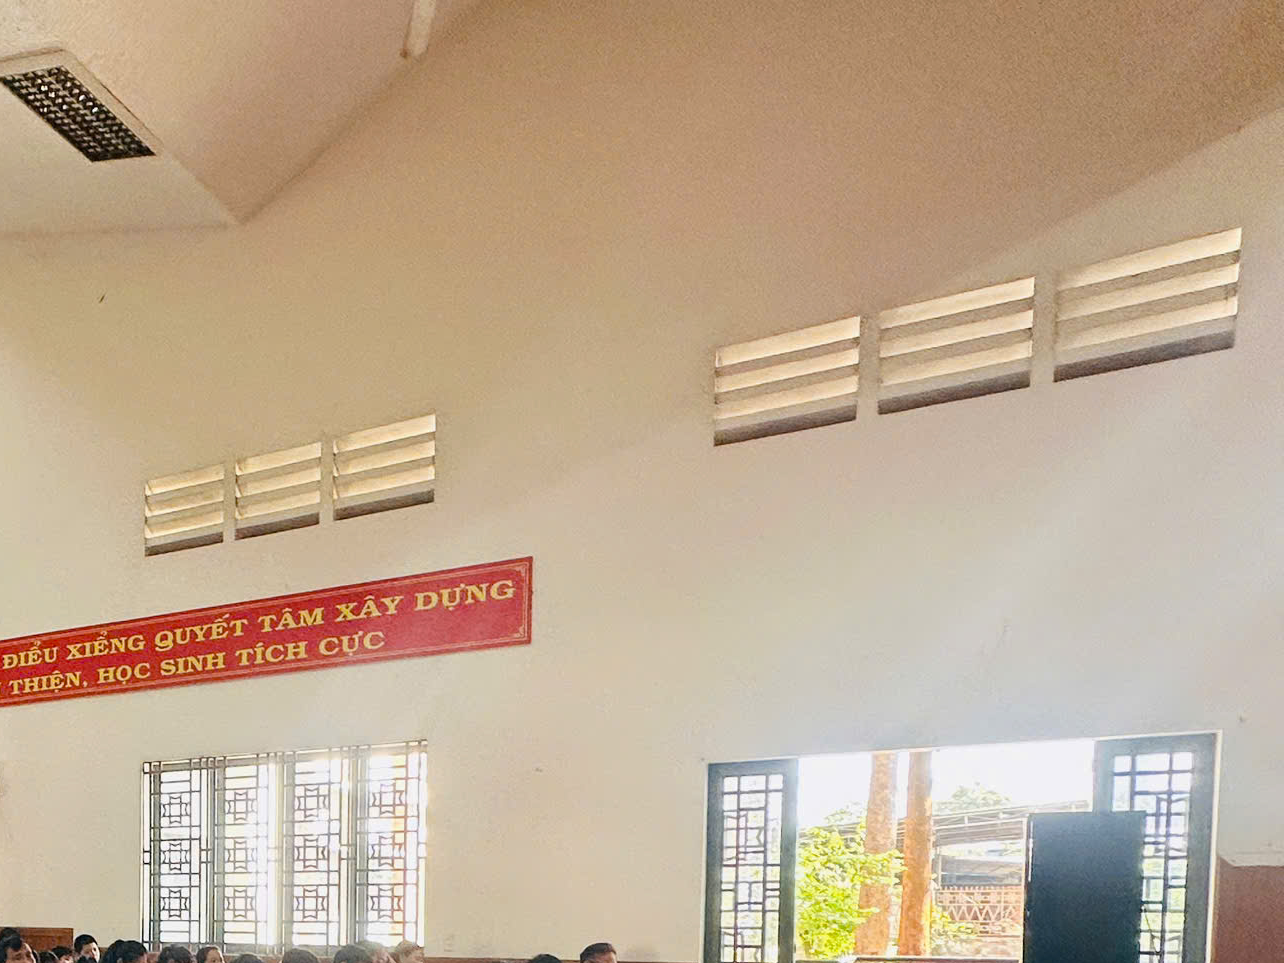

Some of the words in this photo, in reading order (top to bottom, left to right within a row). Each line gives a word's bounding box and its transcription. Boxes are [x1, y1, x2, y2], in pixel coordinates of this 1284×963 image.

[3, 640, 58, 669] ĐIỂU
[155, 614, 248, 652] QUYẾT
[258, 607, 324, 633] TÂM
[335, 594, 404, 622] XÂY
[415, 580, 515, 611] DỰNG
[9, 670, 88, 693] THIỆN,
[97, 663, 150, 685] HỌC
[160, 652, 226, 676] SINH
[235, 641, 308, 666] TÍCH
[318, 630, 385, 656] CỰC
